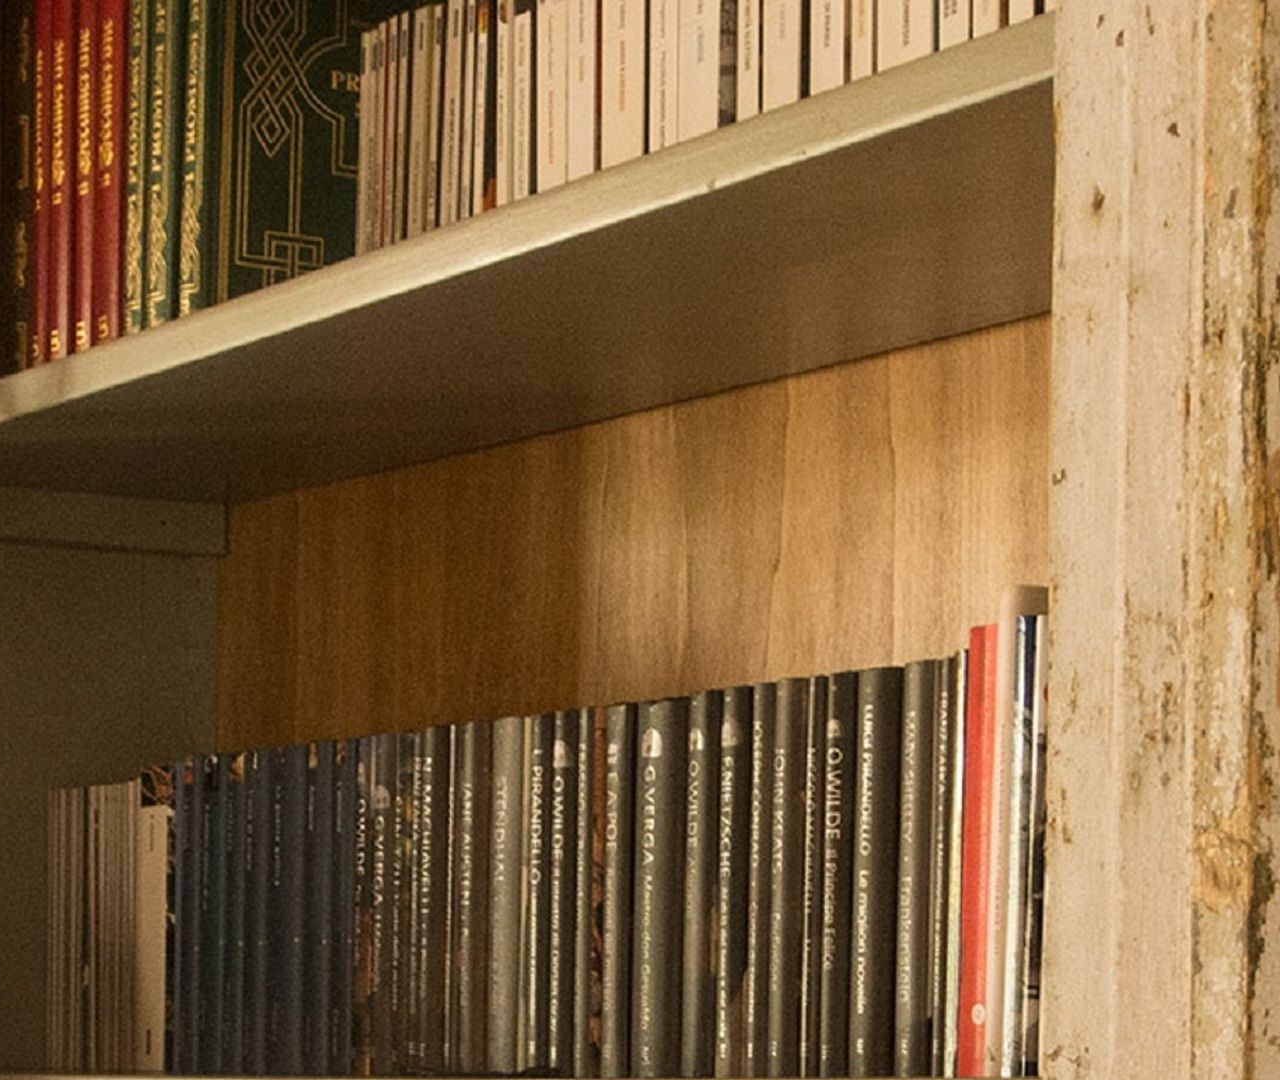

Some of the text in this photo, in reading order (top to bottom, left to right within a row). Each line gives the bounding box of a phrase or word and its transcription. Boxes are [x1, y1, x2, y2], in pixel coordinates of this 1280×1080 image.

[331, 70, 361, 91] PR
[862, 703, 875, 749] LUIGI
[904, 710, 916, 764] MARY
[773, 748, 785, 803] JOHN
[859, 752, 873, 858] PIRANDELLO
[902, 767, 915, 845] SHELLEY
[460, 782, 473, 907] JANE AUSTEN
[494, 774, 509, 884] STENDHAL
[750, 788, 762, 869] CONRAD
[771, 810, 784, 874] KEATS
[823, 861, 837, 925] Principe
[858, 869, 869, 888] Le
[822, 927, 835, 972] Felice
[855, 892, 869, 954] migliori
[900, 875, 913, 1002] Frankenstein
[856, 956, 867, 1015] novelle
